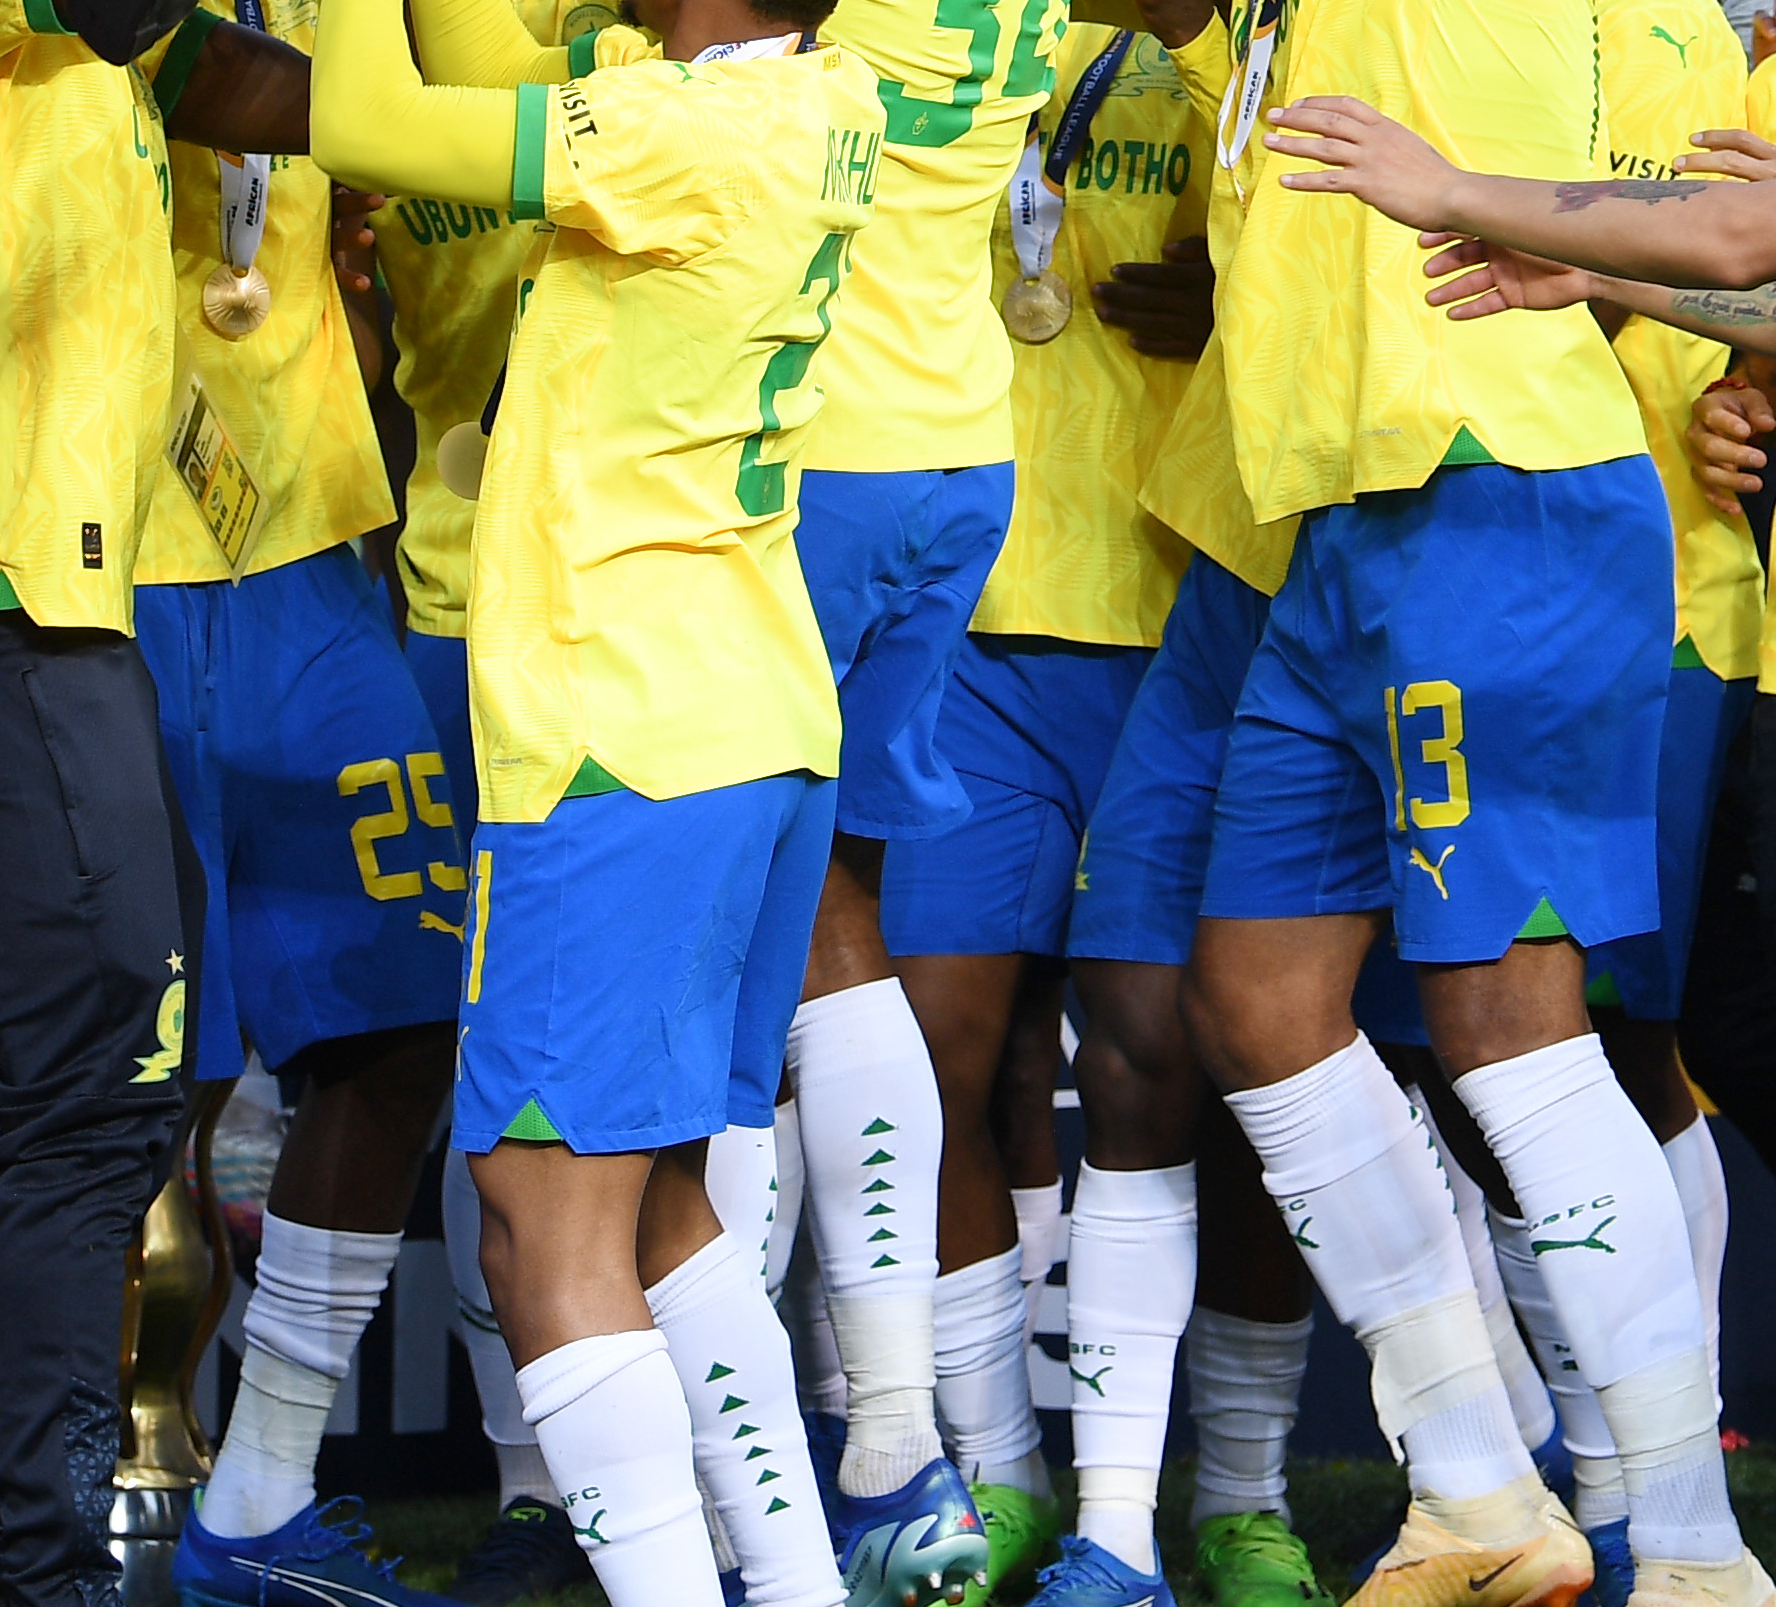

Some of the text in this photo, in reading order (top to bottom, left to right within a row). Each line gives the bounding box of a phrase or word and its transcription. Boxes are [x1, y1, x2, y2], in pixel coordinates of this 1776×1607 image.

[558, 81, 599, 138] VISIT
[1076, 137, 1192, 197] BOTHO
[1609, 149, 1682, 181] VISIT
[397, 197, 517, 246] UBUN
[735, 231, 852, 518] 2
[1384, 679, 1471, 830] 13
[337, 751, 467, 901] 25
